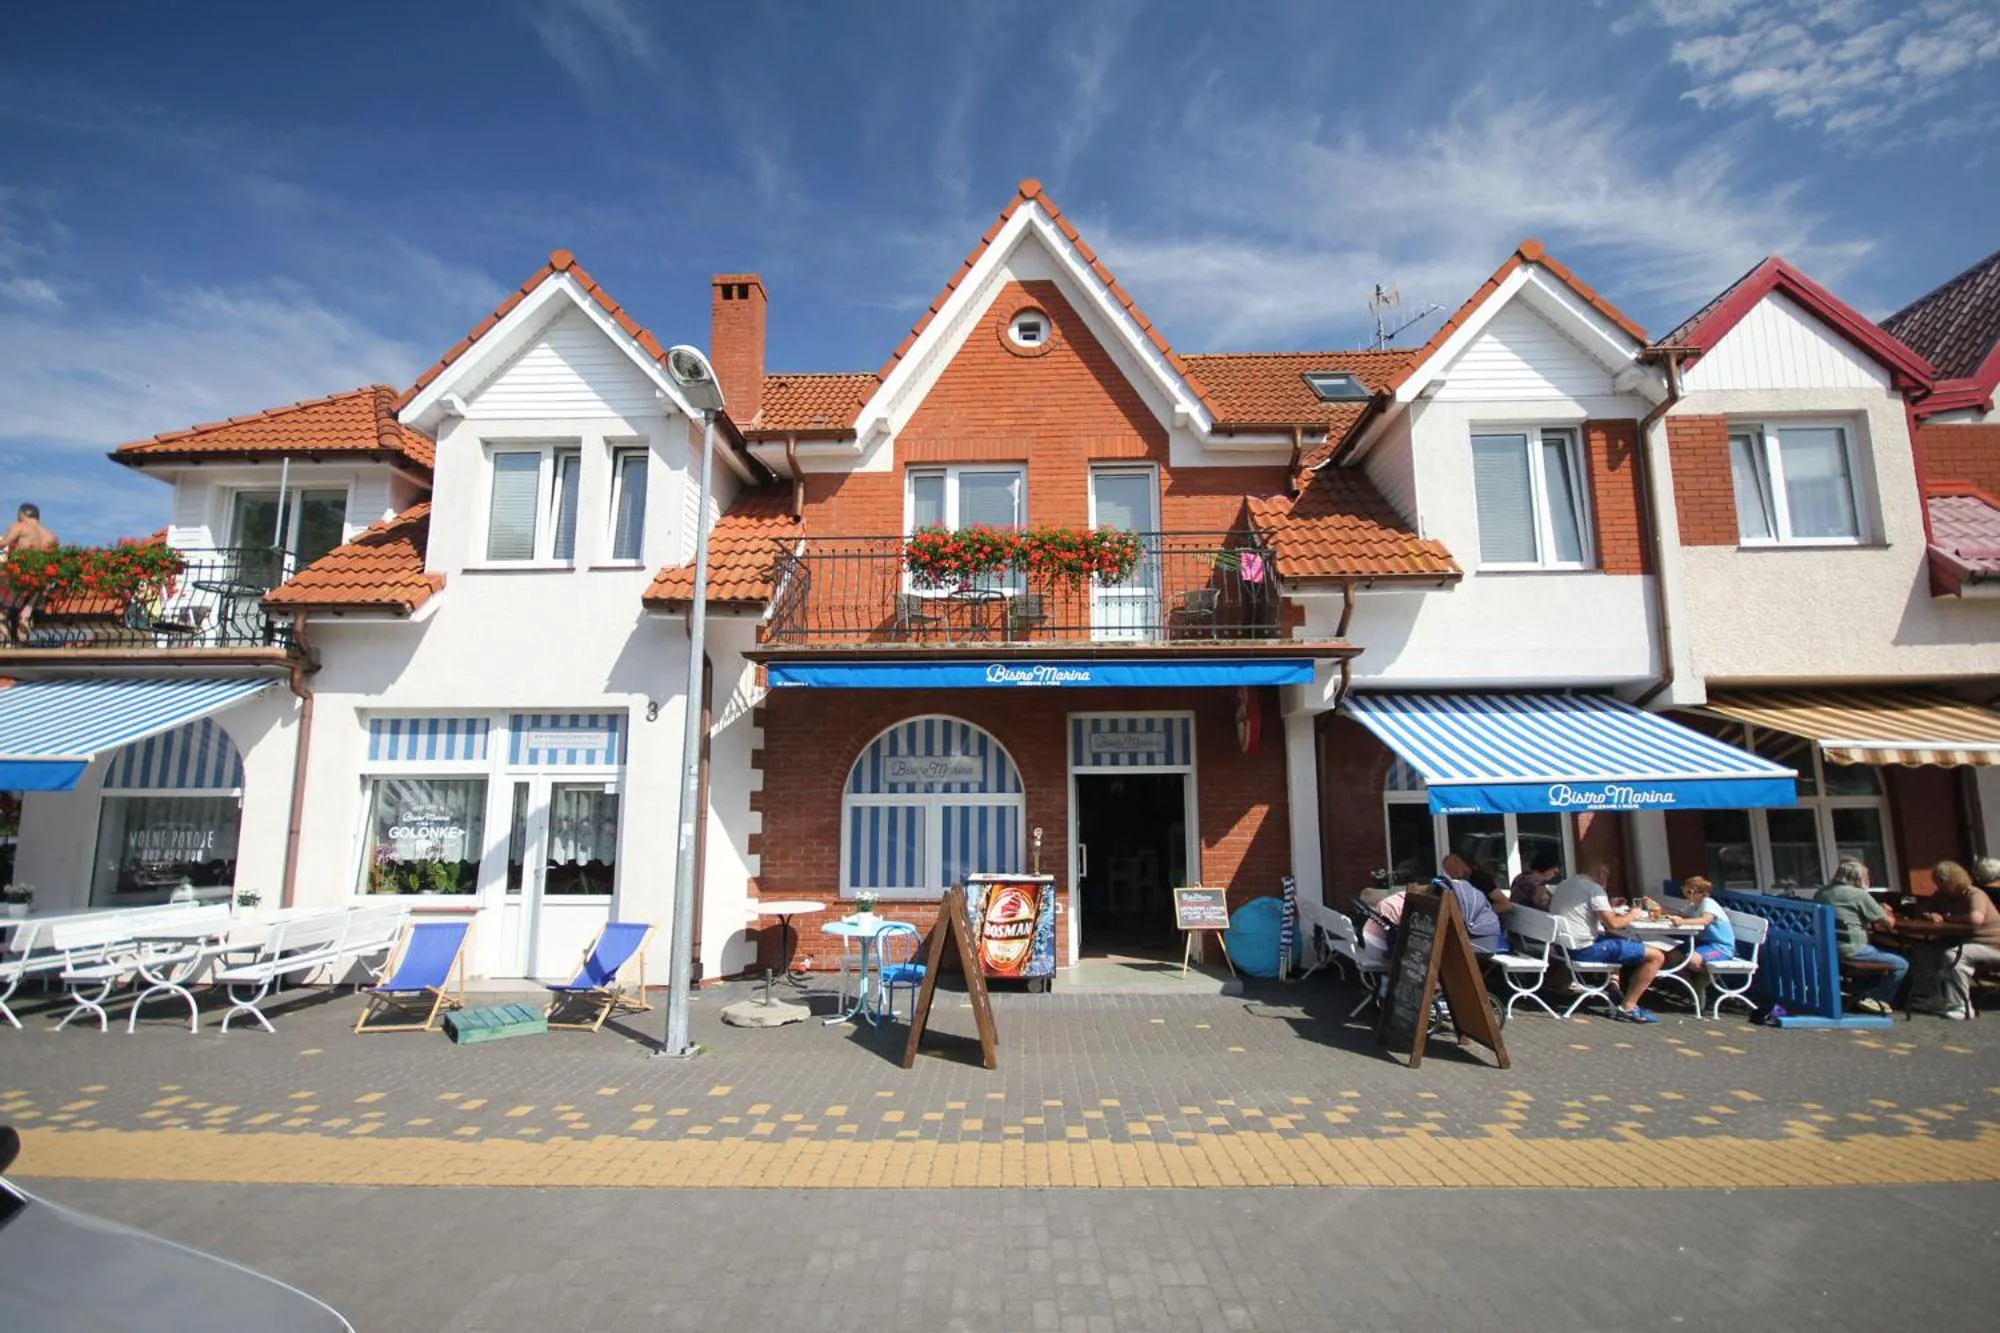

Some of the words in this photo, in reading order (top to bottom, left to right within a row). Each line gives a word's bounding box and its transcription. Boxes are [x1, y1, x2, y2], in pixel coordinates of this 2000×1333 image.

[986, 664, 1033, 682] Bistro
[1033, 665, 1091, 681] Marina
[646, 701, 658, 722] 3
[1548, 784, 1606, 806] Bistro
[1604, 785, 1676, 804] Marina
[129, 830, 166, 848] WOLNE
[171, 830, 214, 848] POKOJE
